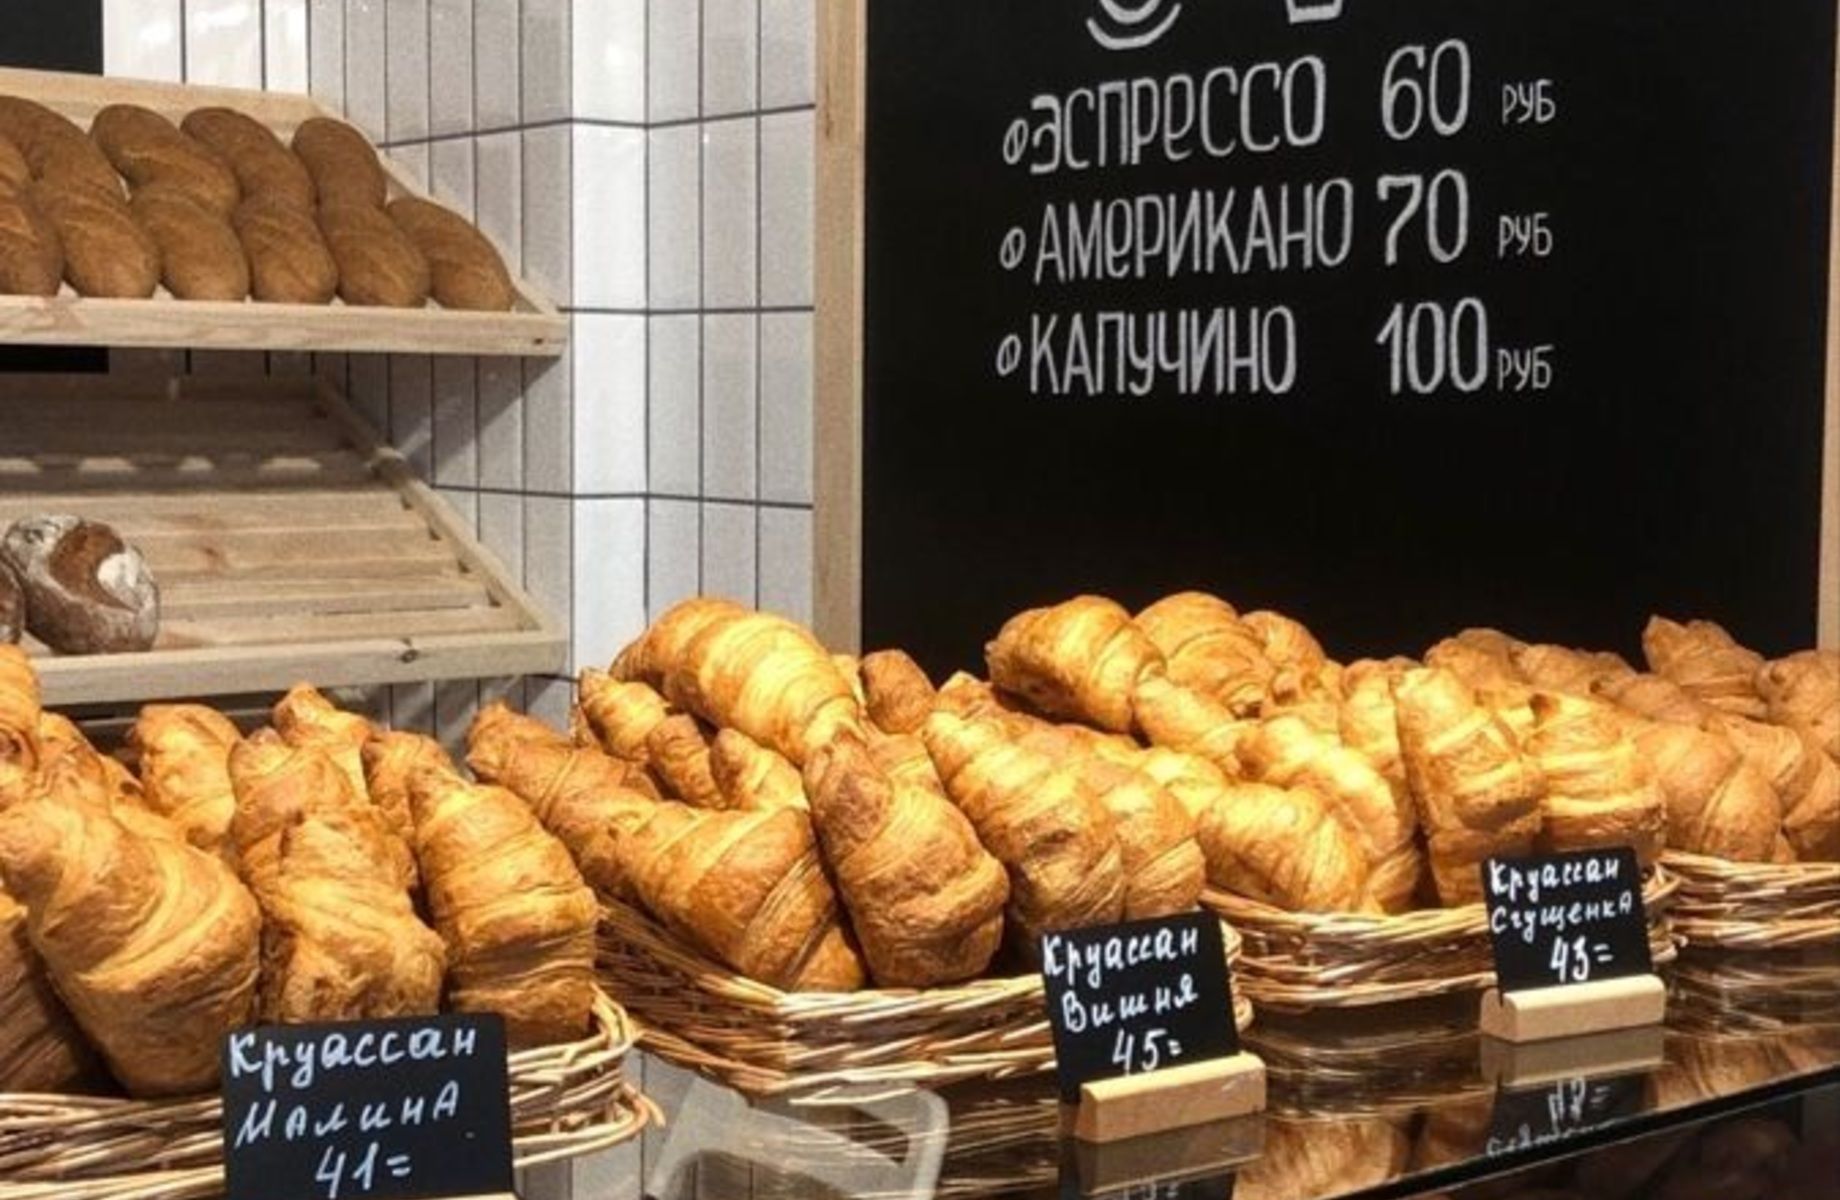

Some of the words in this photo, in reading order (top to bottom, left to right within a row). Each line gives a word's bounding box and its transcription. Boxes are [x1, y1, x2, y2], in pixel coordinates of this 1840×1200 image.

[1381, 39, 1470, 140] 60
[1377, 169, 1468, 265] 70
[1376, 298, 1488, 394] 100
[1489, 858, 1620, 900] Круассан
[1042, 928, 1198, 988] Круассан
[1061, 974, 1198, 1032] Вишня
[229, 1028, 476, 1092] Круассан
